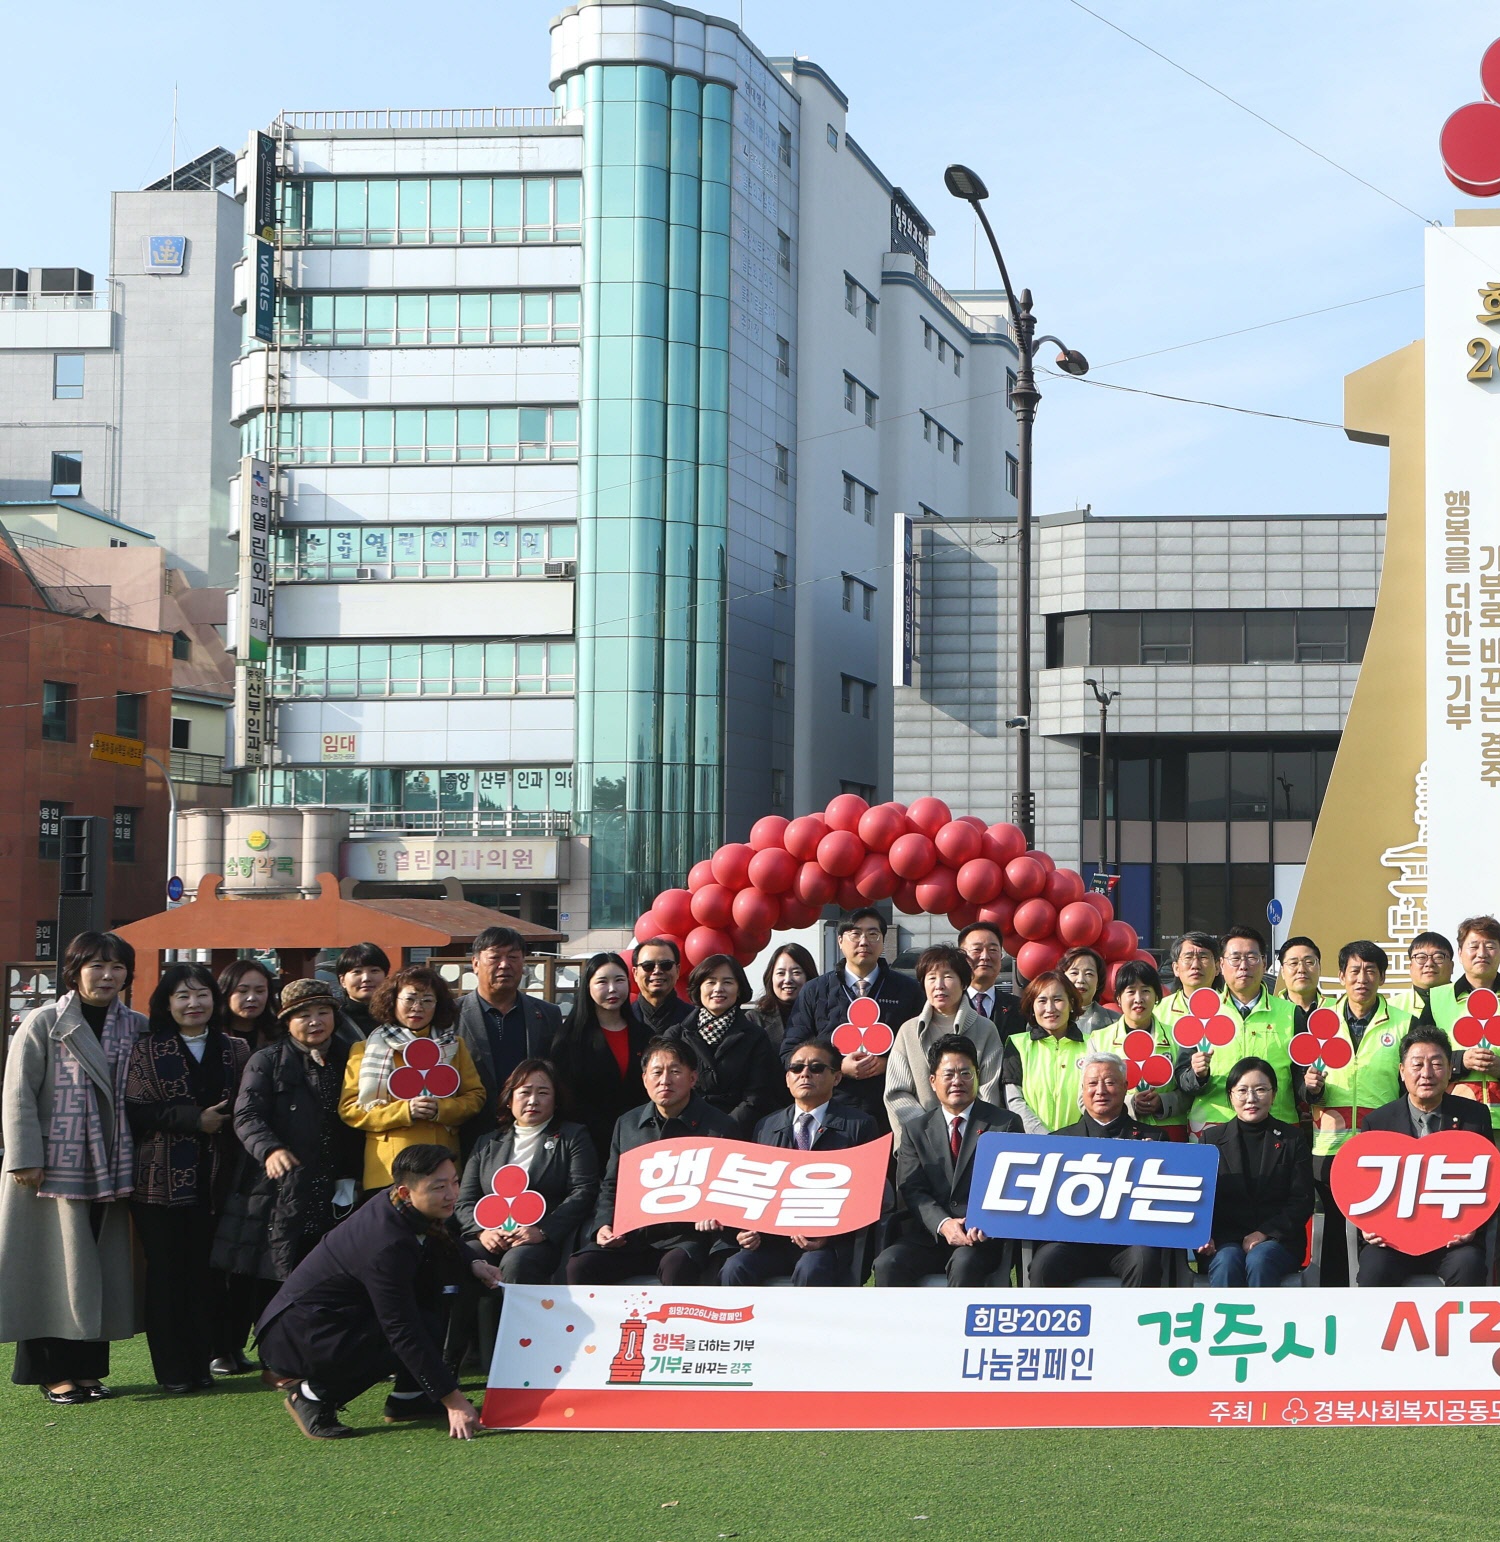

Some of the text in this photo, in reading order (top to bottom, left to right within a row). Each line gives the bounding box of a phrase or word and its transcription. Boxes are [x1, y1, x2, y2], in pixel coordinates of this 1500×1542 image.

[260, 254, 271, 312] wells
[251, 511, 268, 608] 열린외과
[1443, 489, 1472, 731] 행복을 더하는 기부
[250, 617, 267, 631] 의원
[247, 682, 262, 751] 산부인과
[323, 734, 356, 753] 임대
[445, 771, 470, 792] 중앙
[40, 823, 59, 835] 의원
[114, 828, 131, 839] 의원
[225, 856, 294, 878] 소망약국
[393, 848, 533, 871] 열린외과의원
[637, 1146, 853, 1228] 행복을
[981, 1151, 1204, 1224] 더하는
[1348, 1153, 1493, 1219] 기부
[971, 1307, 1083, 1335] 희망2026
[652, 1333, 755, 1352] 행복을 더하는 기부
[1137, 1302, 1337, 1383] 경주시
[648, 1356, 753, 1375] 기부로 바꾸는 경주
[961, 1347, 1094, 1382] 나눔캠페인
[1209, 1400, 1254, 1423] 주최
